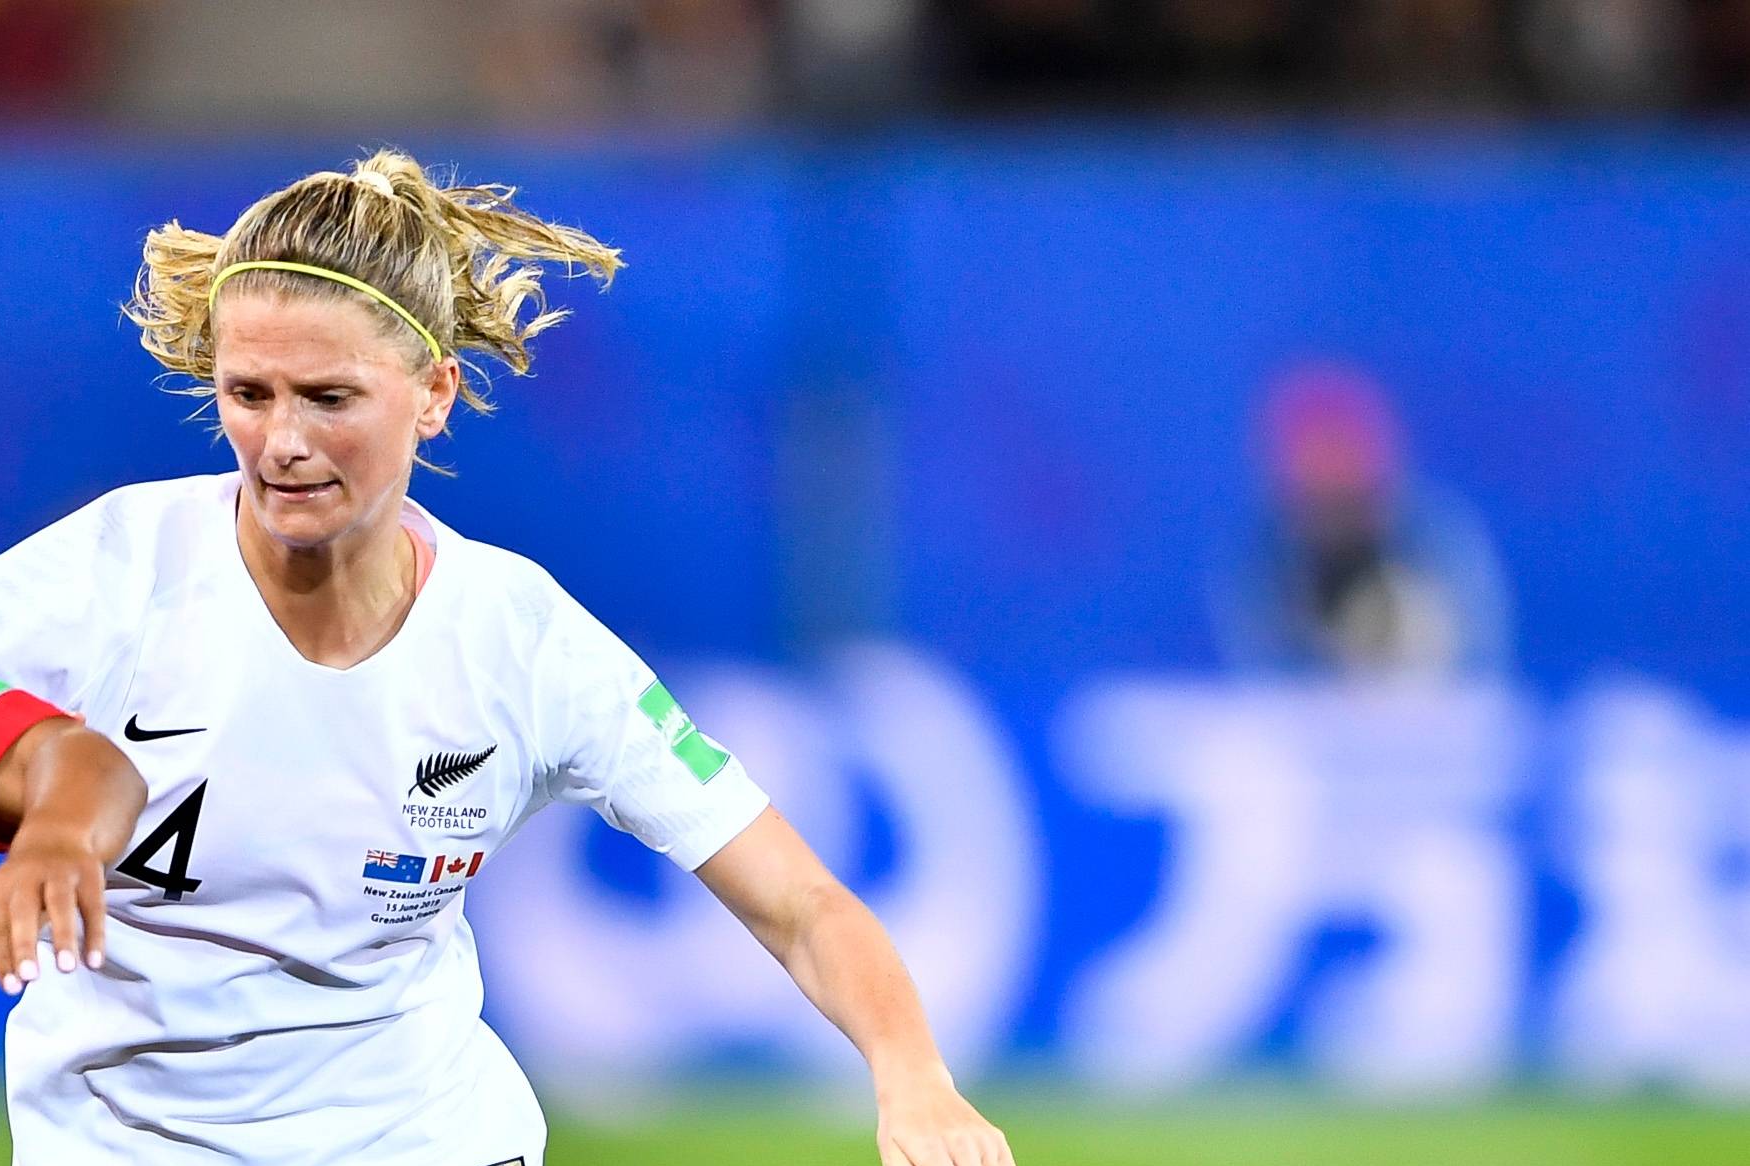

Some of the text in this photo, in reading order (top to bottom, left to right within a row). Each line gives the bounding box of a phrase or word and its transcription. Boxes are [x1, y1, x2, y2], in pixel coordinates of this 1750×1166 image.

[402, 804, 487, 819] NEW ZEALAND
[410, 816, 475, 829] FOOTBALL
[114, 778, 208, 902] 4
[363, 885, 388, 898] New
[388, 889, 428, 900] Zealand
[386, 903, 398, 912] 15
[398, 904, 419, 912] June
[370, 913, 414, 924] Grenoble
